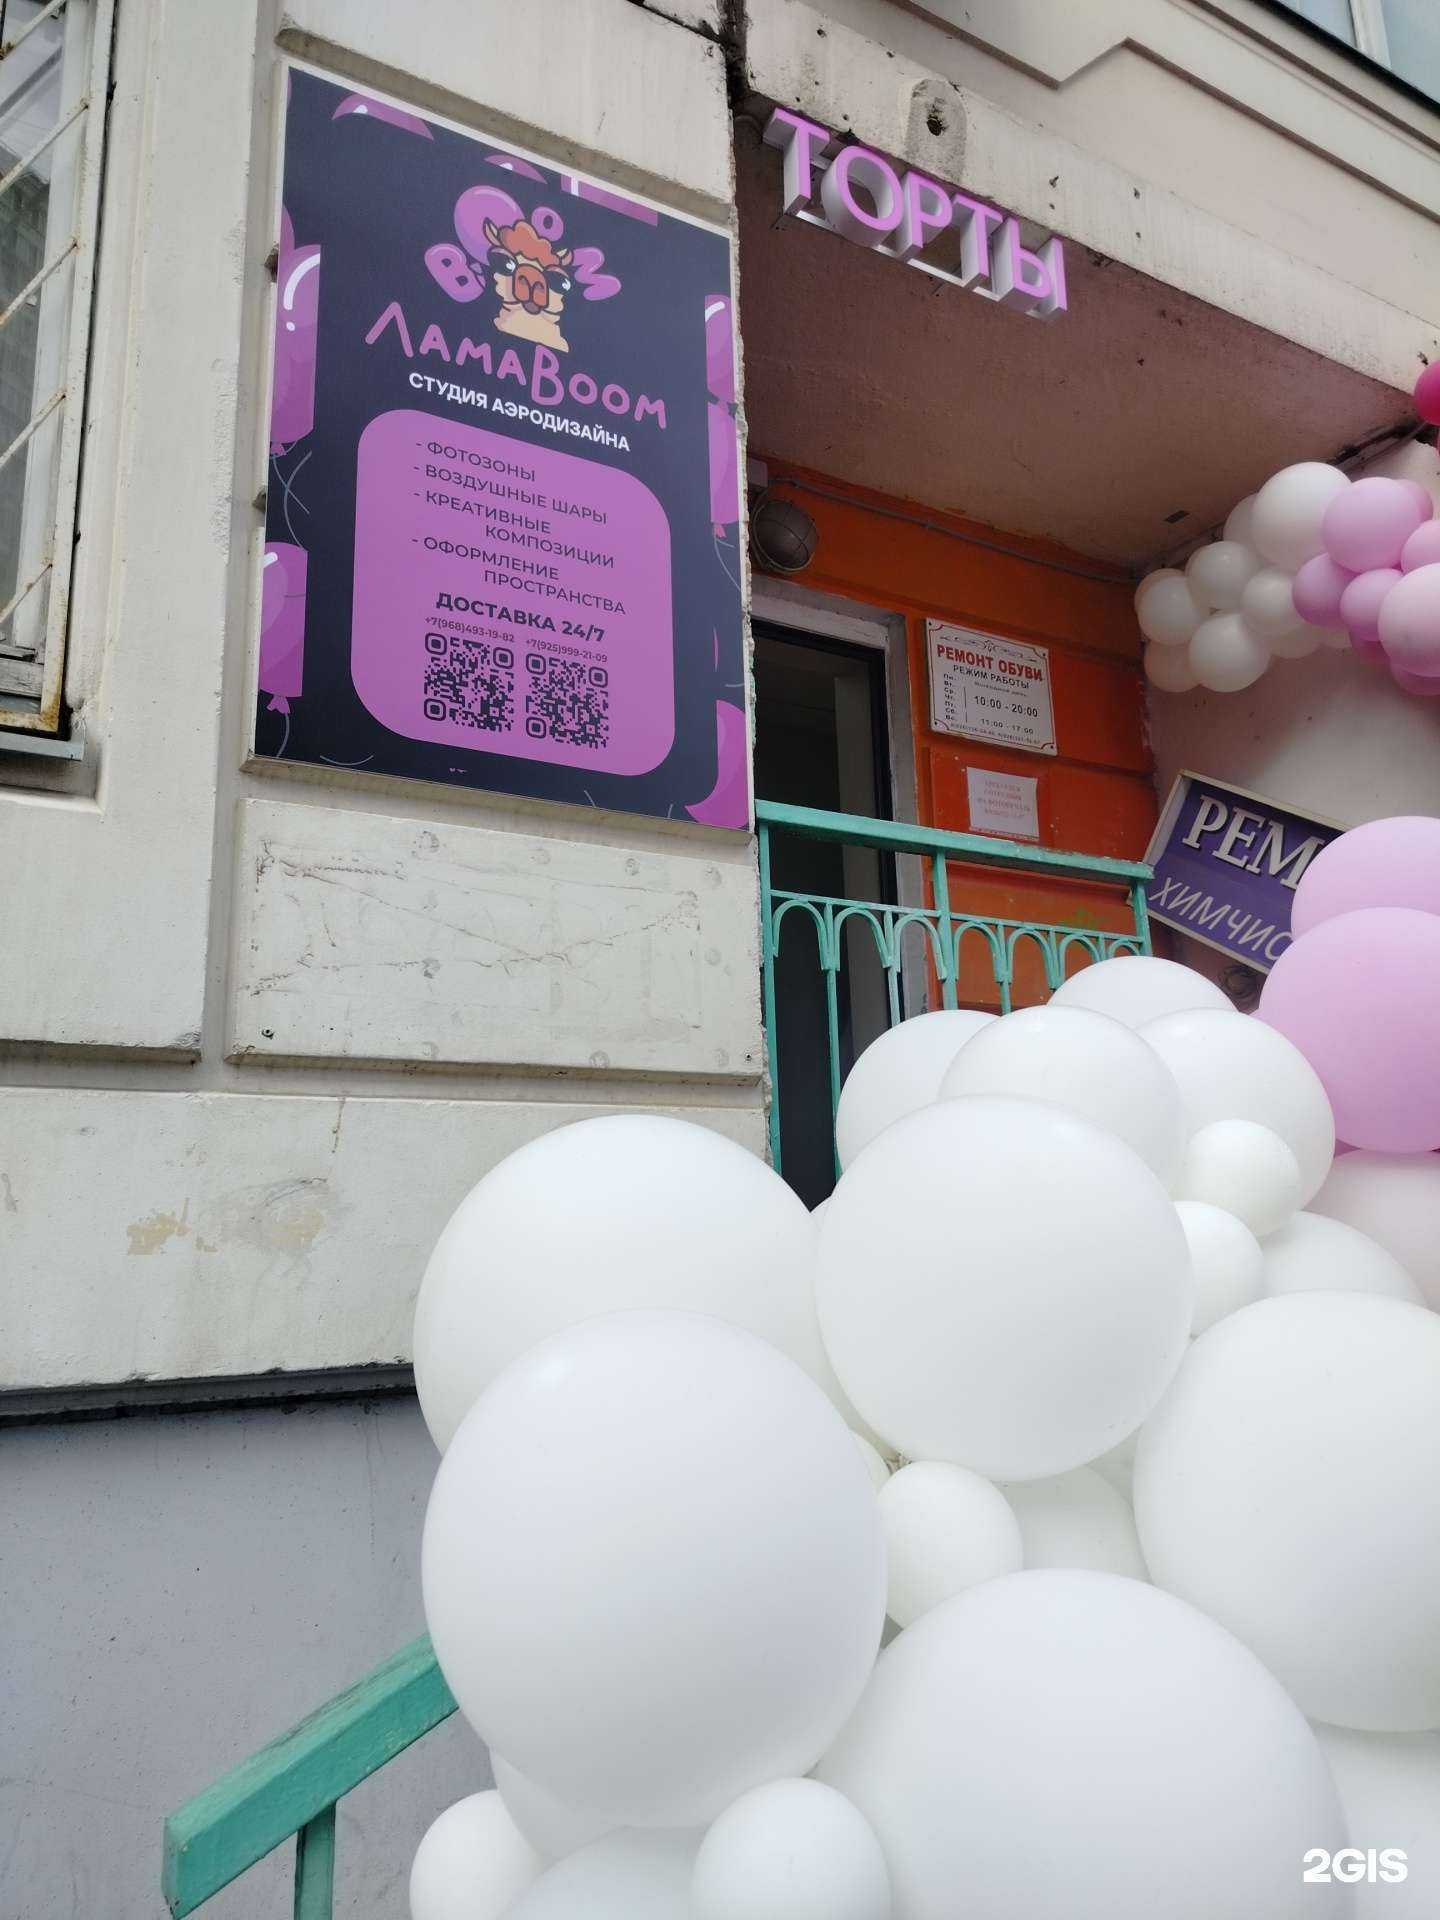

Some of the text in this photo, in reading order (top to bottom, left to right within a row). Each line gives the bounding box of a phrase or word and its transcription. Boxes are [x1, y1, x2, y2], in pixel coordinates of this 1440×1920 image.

[763, 107, 1068, 318] ТОРТЫ
[408, 371, 631, 452] СТУДИЯ АЭРОДИЗАЙНА
[427, 441, 536, 483] ФОТОЗОНЫ
[425, 464, 547, 509] ВОЗДУШНЫЕ
[552, 499, 608, 525] ШАРЫ
[426, 491, 552, 534] КРЕАТИВНЫЕ
[424, 536, 560, 581] ОФОРМЛЕНИЕ
[485, 524, 615, 569] КОМПОЗИЦИИ
[484, 570, 627, 615] ПРОСТРАНСТВА
[436, 592, 605, 642] ДОСТАВКА 24/7
[937, 644, 1043, 682] РЕМОНТ ОБУВИ
[953, 664, 988, 680] РЕЖИМ
[990, 673, 1030, 689] РАБОТЫ
[1011, 703, 1038, 718] 20:00
